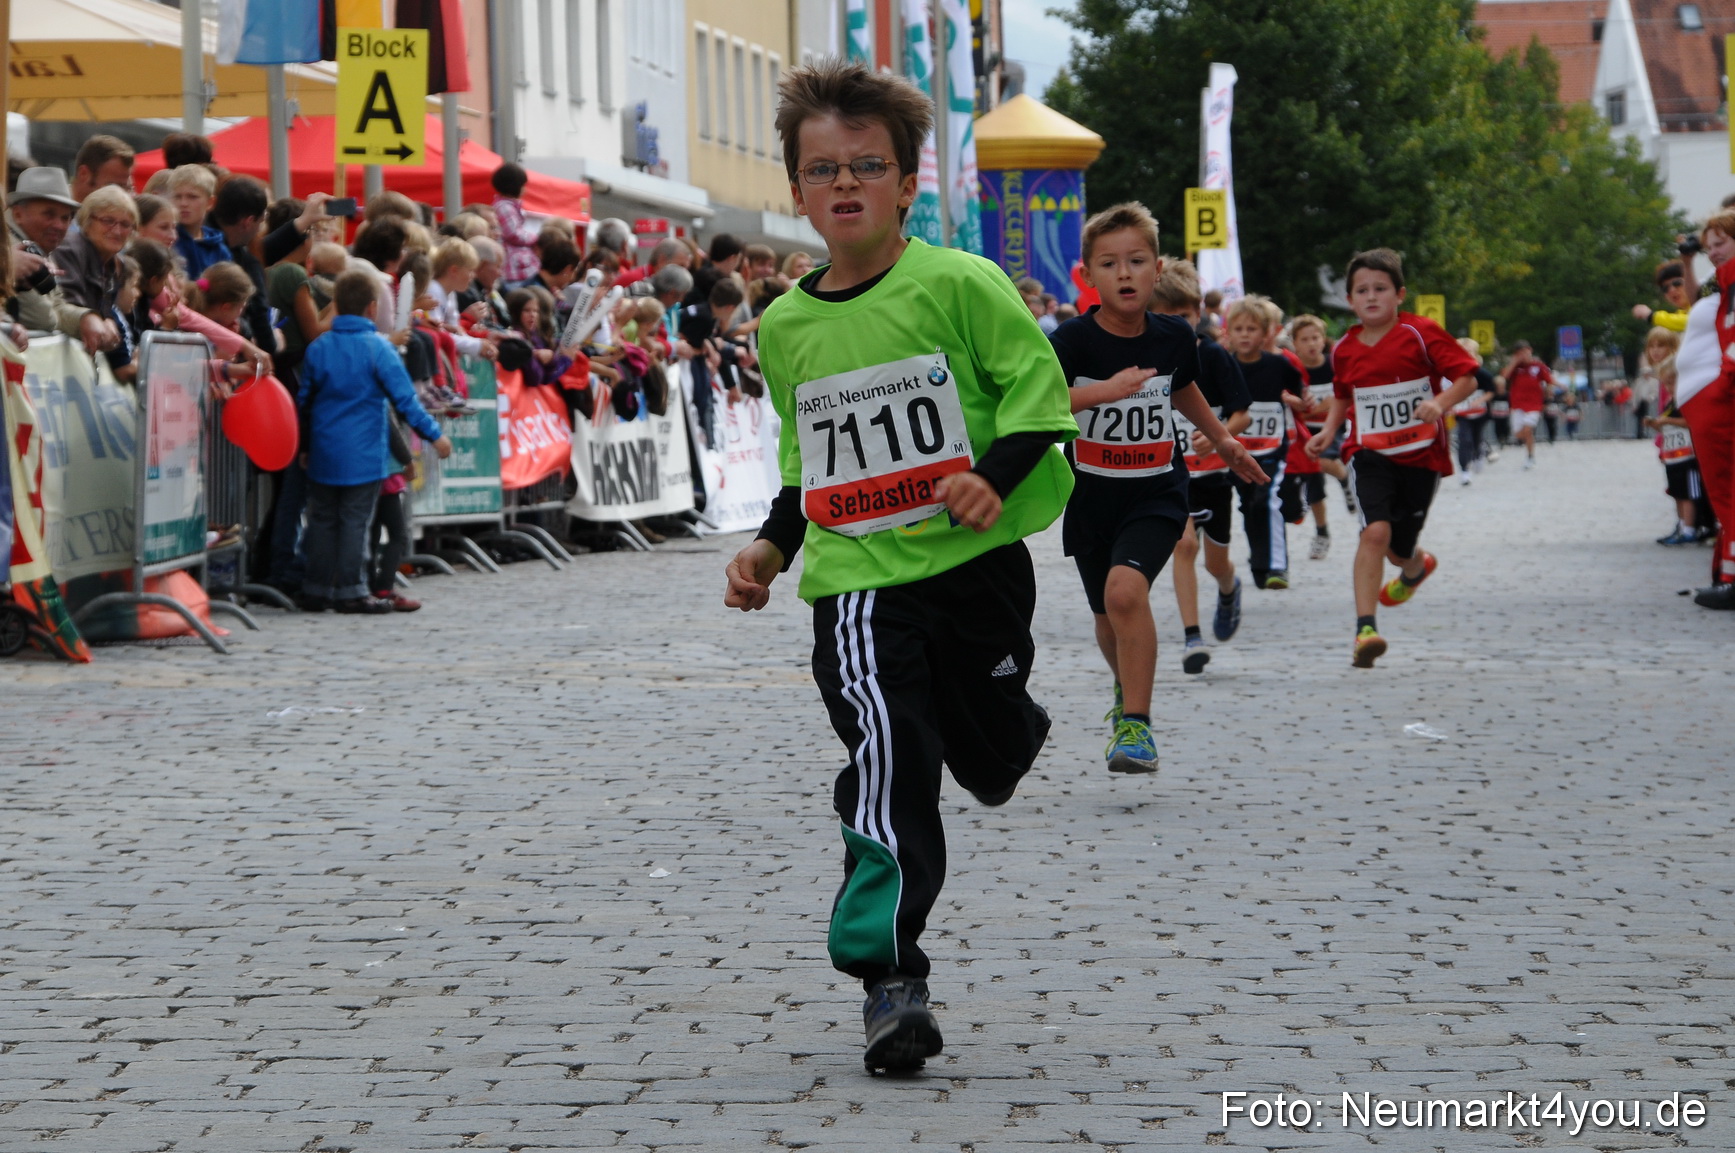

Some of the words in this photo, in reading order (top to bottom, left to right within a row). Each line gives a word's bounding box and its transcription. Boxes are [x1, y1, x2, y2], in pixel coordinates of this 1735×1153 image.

[347, 33, 416, 58] Block
[354, 69, 405, 134] A
[1198, 207, 1217, 236] B
[797, 394, 838, 417] PARTL
[839, 375, 922, 406] Neumarkt
[1382, 387, 1420, 400] Neumarkt
[812, 396, 944, 478] 7110
[1084, 404, 1165, 442] 7205
[1102, 449, 1147, 466] Robin
[991, 666, 1019, 677] adidas
